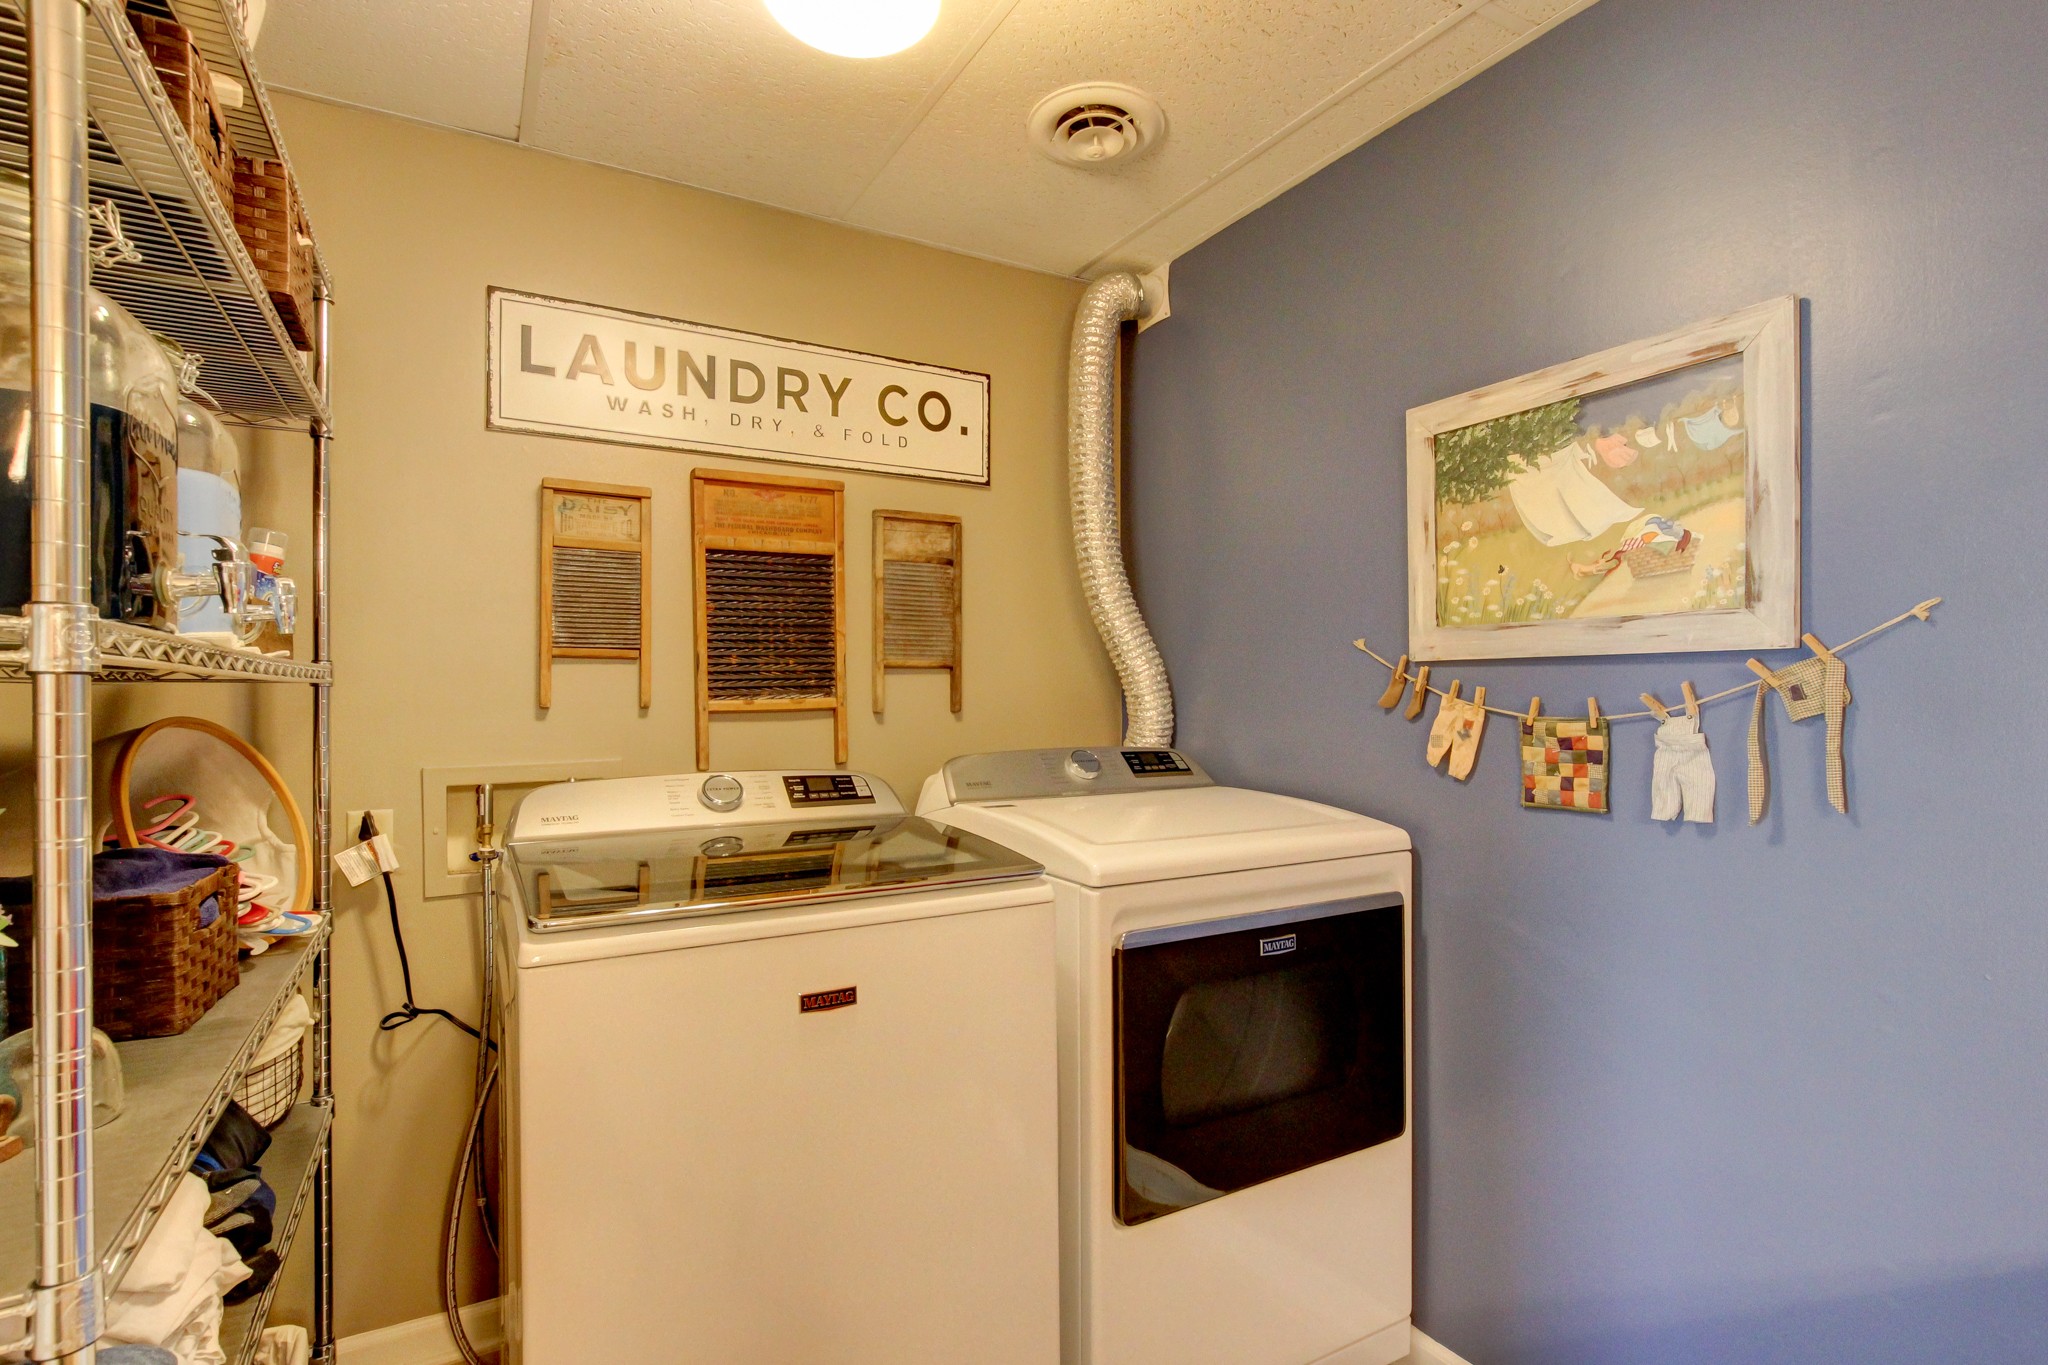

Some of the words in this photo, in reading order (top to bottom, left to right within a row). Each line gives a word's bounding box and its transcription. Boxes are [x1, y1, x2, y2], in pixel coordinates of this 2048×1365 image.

[520, 324, 853, 418] LAUNDRY
[877, 384, 969, 436] CO.
[606, 394, 708, 426] WASH,
[730, 412, 796, 438] DRY,
[813, 423, 825, 438] &
[843, 428, 908, 449] FOLD
[560, 496, 633, 517] DAISY
[541, 814, 580, 823] MAYTAG
[1263, 939, 1294, 953] MAYTAG
[803, 990, 855, 1009] MAYTAG
